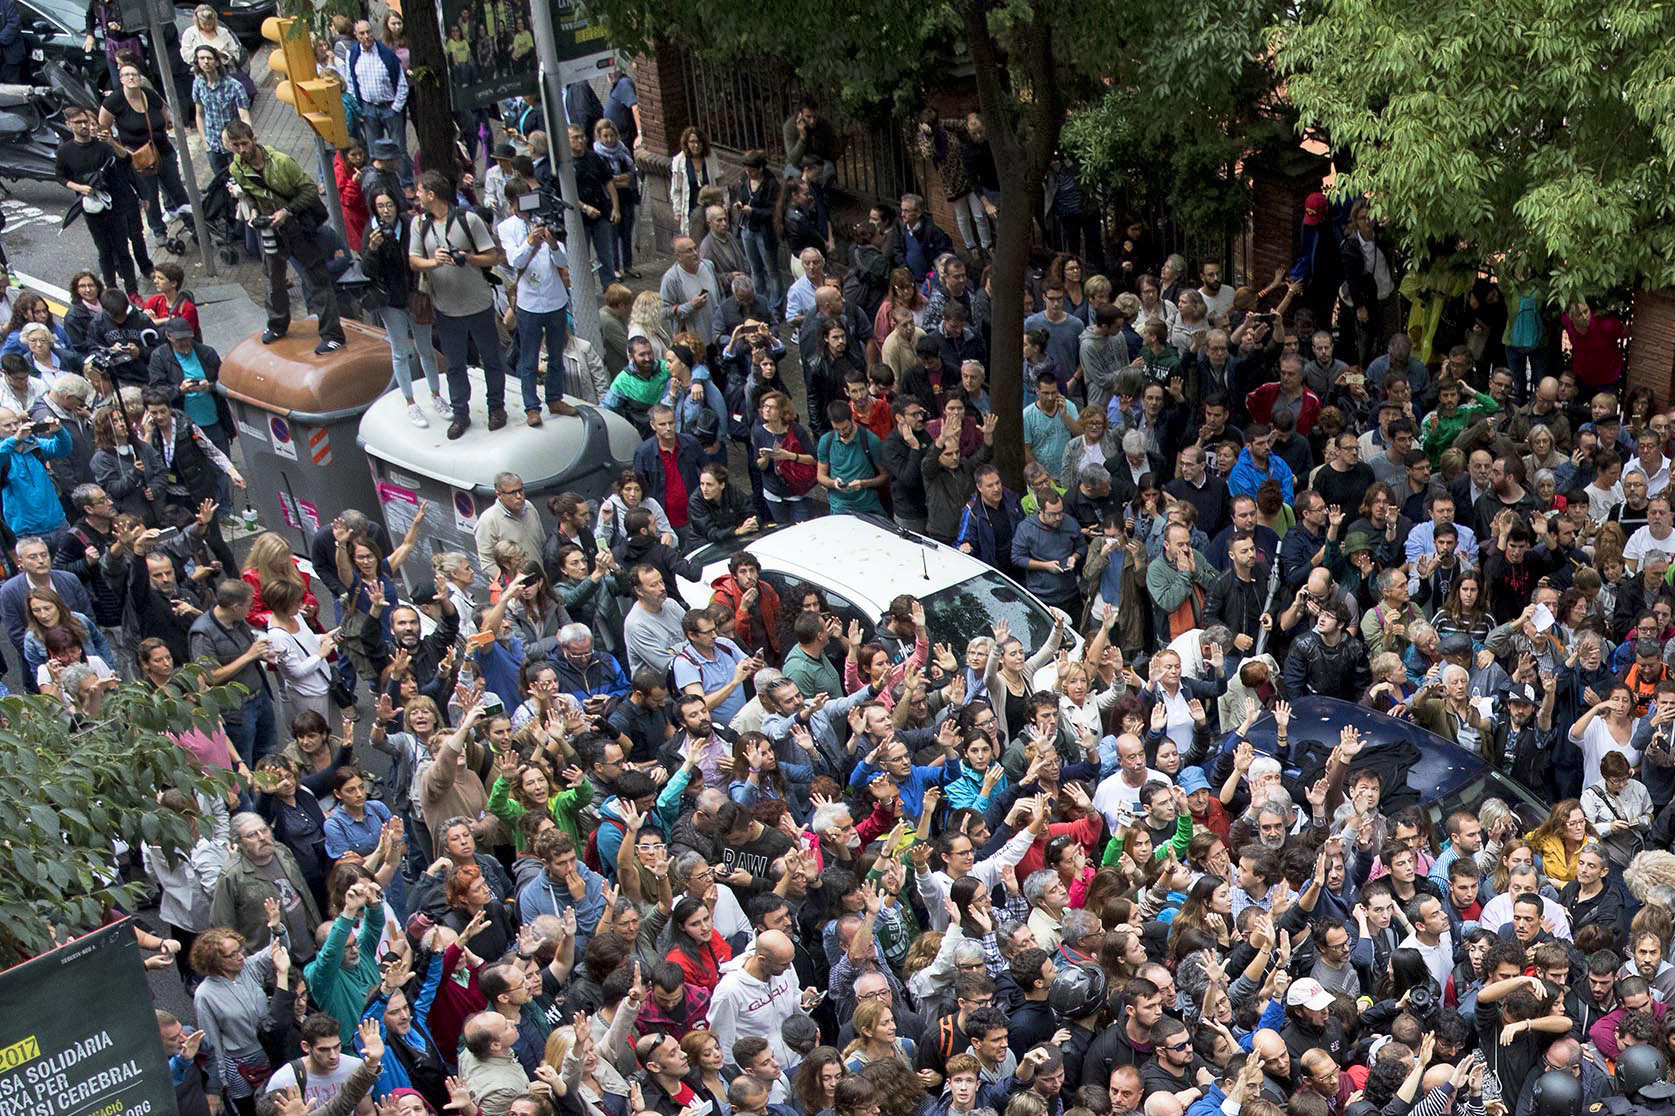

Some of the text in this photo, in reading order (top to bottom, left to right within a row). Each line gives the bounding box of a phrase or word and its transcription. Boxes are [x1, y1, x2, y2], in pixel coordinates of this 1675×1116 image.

[724, 848, 768, 878] RAW
[0, 1031, 113, 1099] SA SOLIDÀRIA
[58, 1060, 142, 1110] CEREBRAL
[35, 1073, 69, 1101] PER
